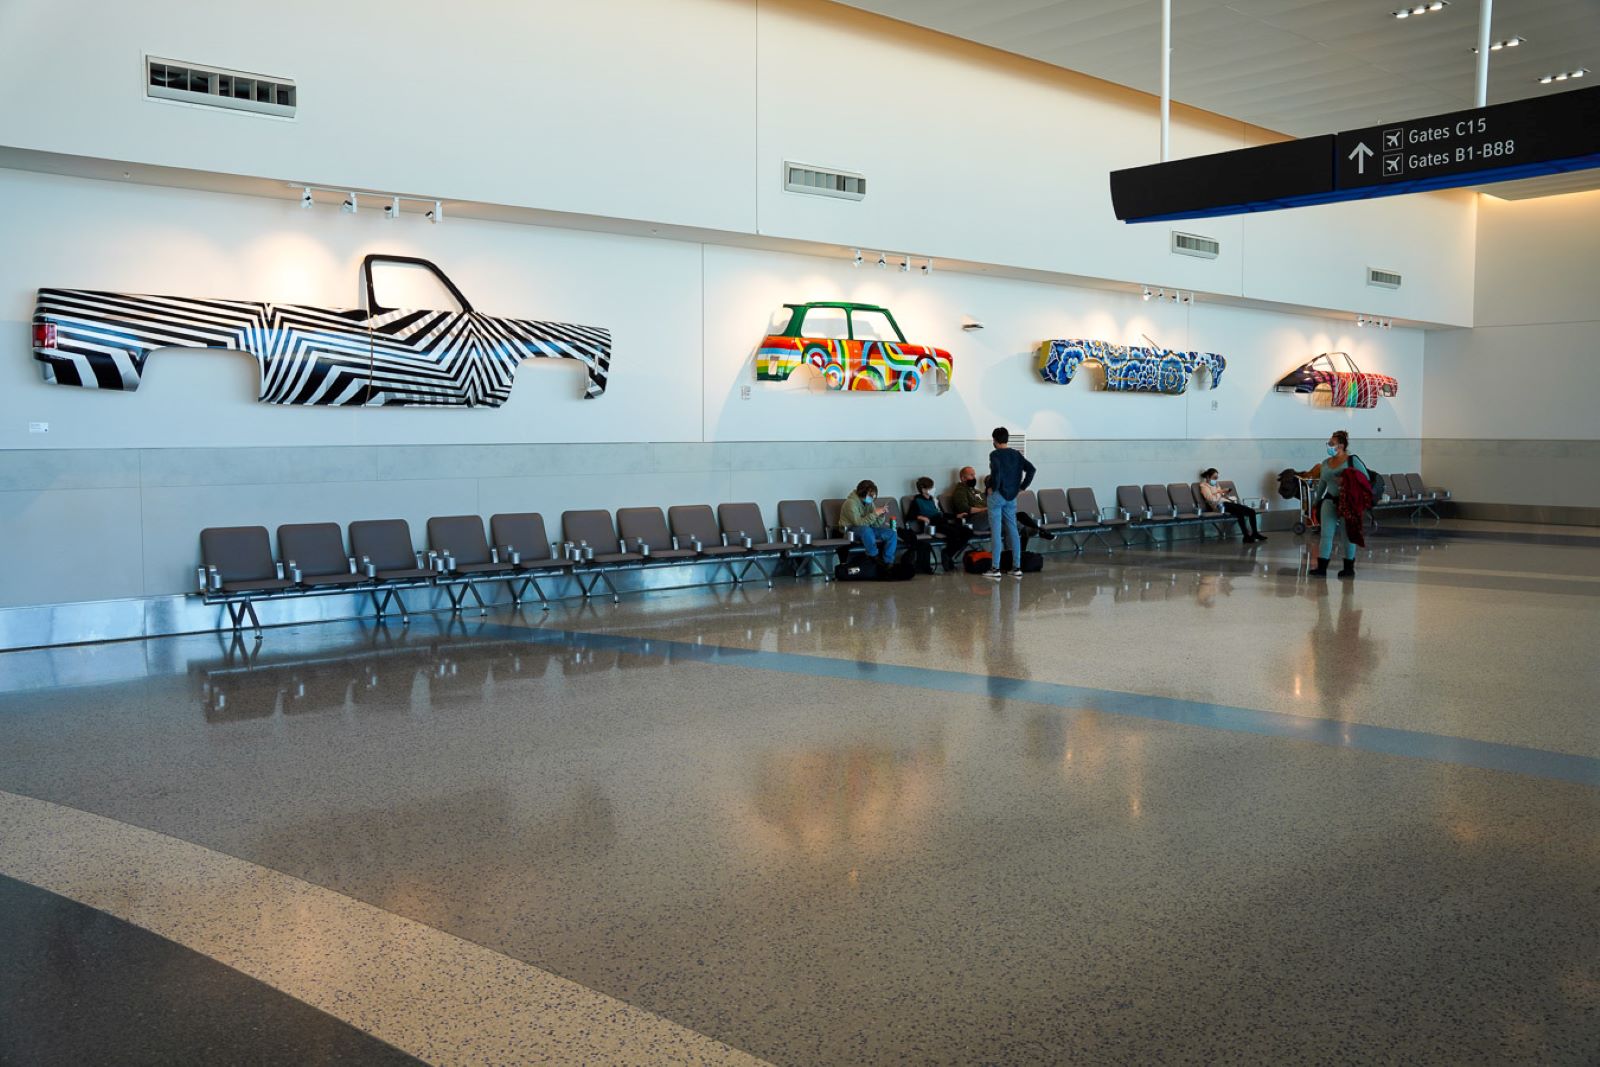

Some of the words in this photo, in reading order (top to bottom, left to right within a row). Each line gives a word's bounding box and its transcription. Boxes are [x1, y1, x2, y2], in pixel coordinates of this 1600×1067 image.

[1409, 127, 1450, 143] Gates
[1456, 117, 1487, 136] C15
[1408, 153, 1449, 169] Gates
[1455, 140, 1514, 162] B1-B88
